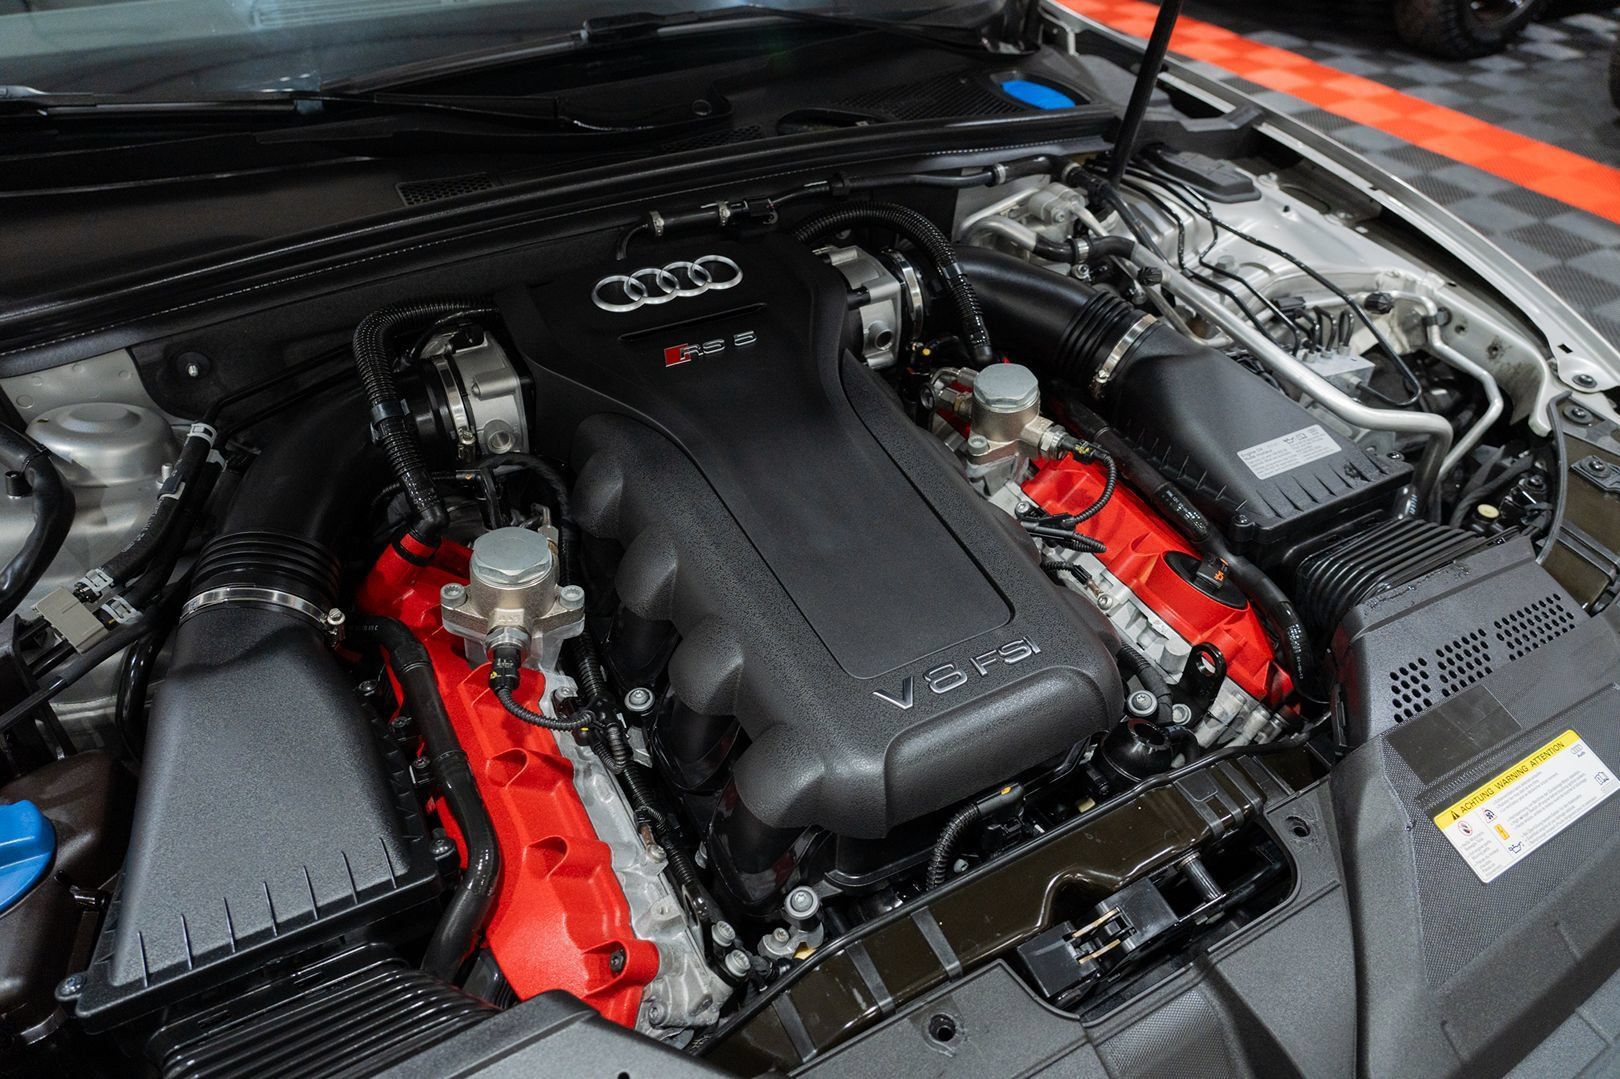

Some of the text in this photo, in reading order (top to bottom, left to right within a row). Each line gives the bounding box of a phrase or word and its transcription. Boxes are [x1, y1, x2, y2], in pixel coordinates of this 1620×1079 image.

[664, 330, 757, 367] RS 5
[969, 635, 1041, 676] FSI
[1460, 741, 1565, 813] ACHTUNG WARNING ATTENTION
